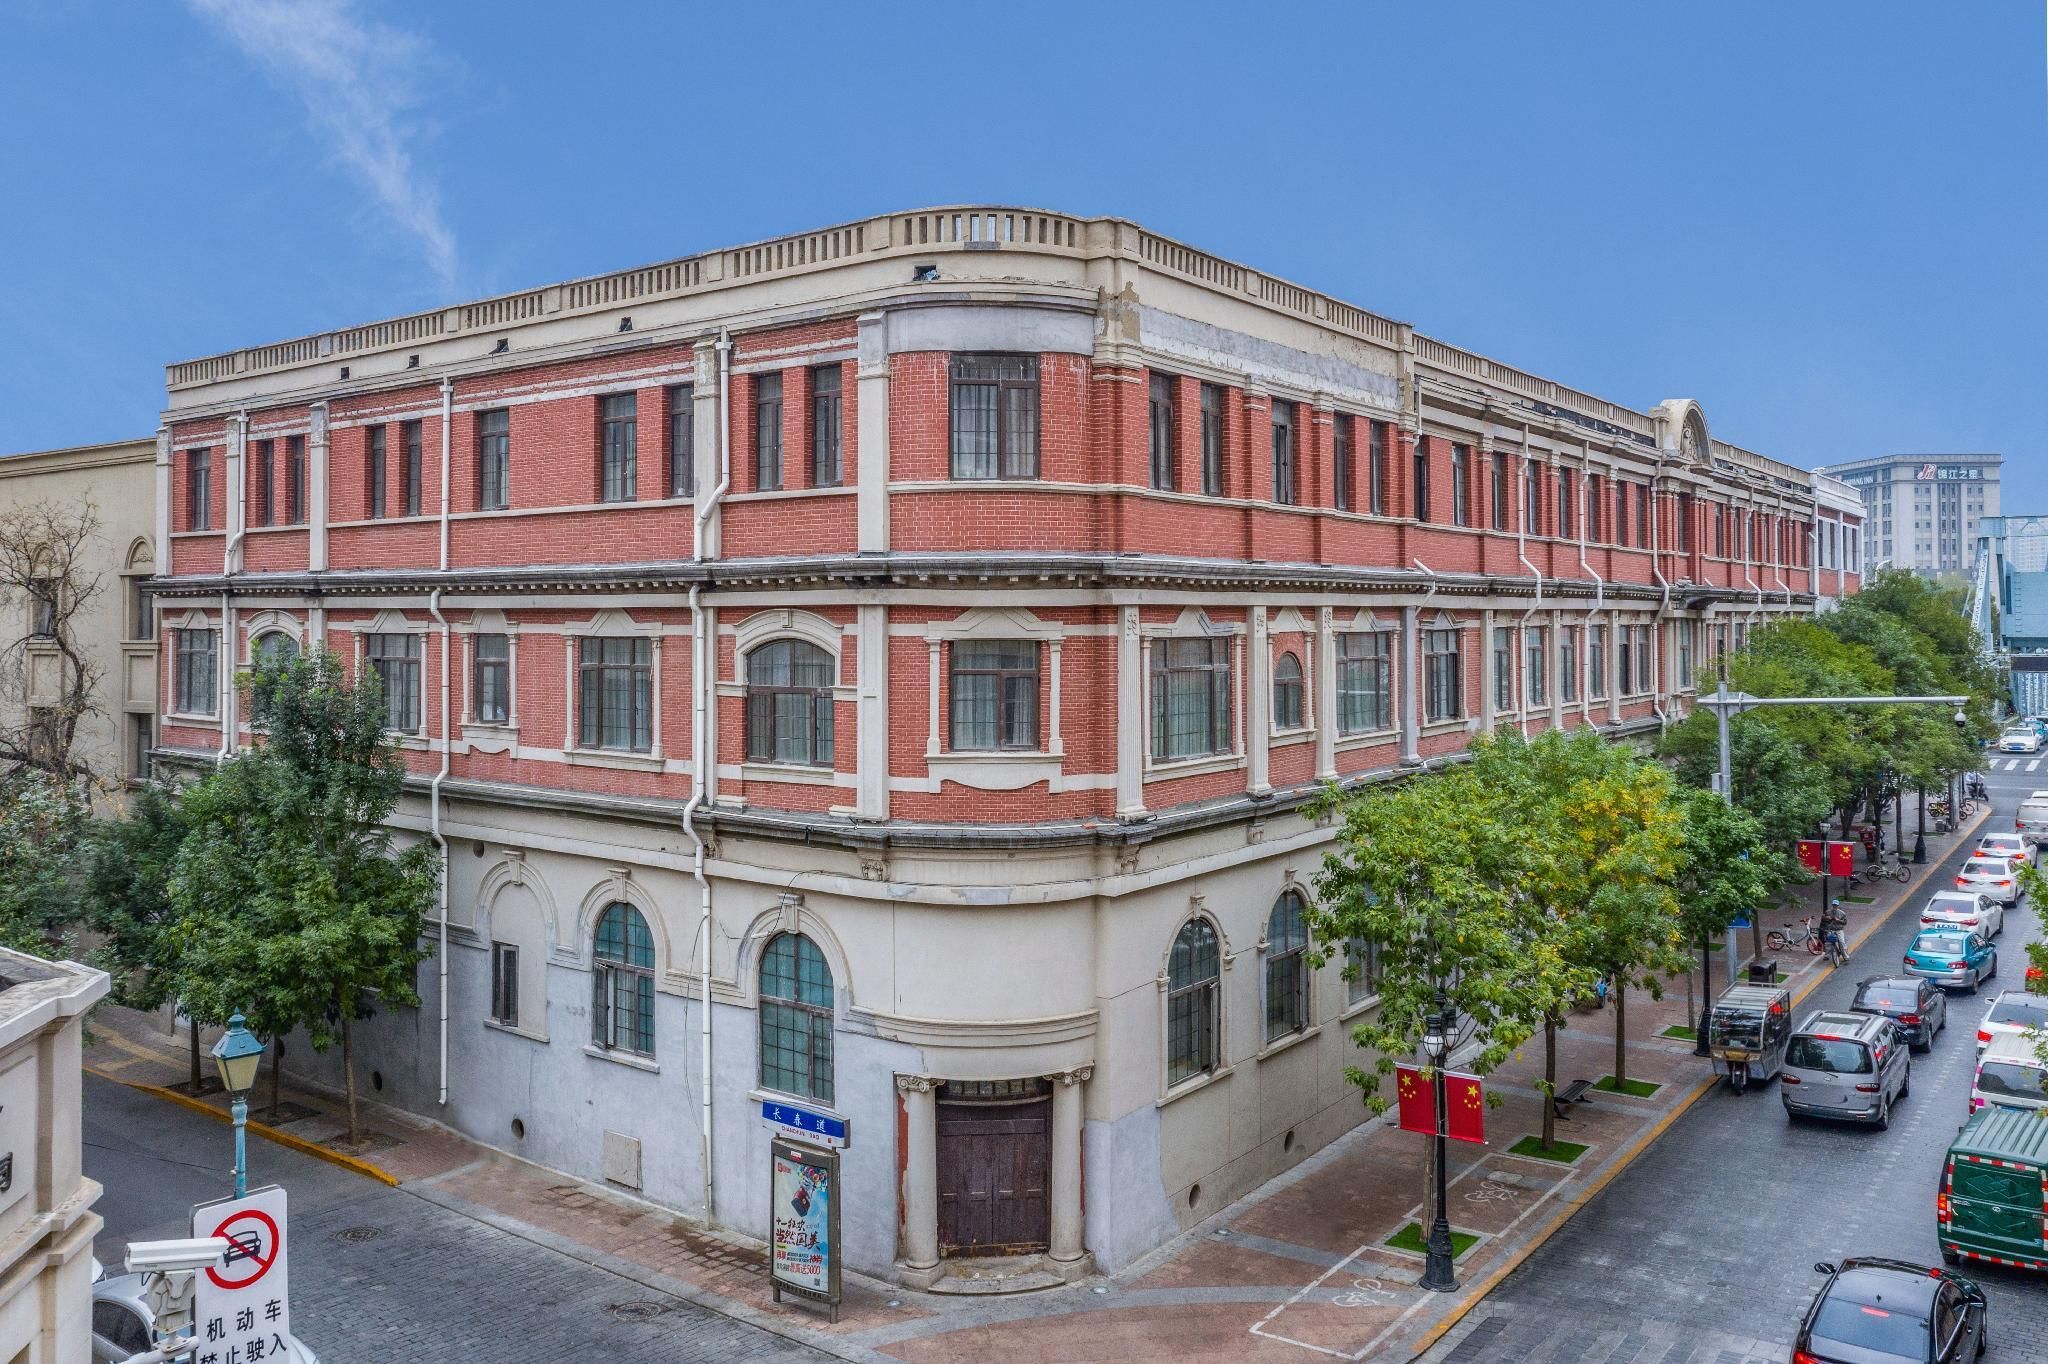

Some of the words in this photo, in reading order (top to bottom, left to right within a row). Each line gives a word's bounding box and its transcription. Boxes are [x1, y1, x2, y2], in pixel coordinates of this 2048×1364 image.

[1937, 469, 1978, 480] 锦江之星
[773, 1107, 826, 1132] 长春道
[207, 1300, 281, 1342] 机动车
